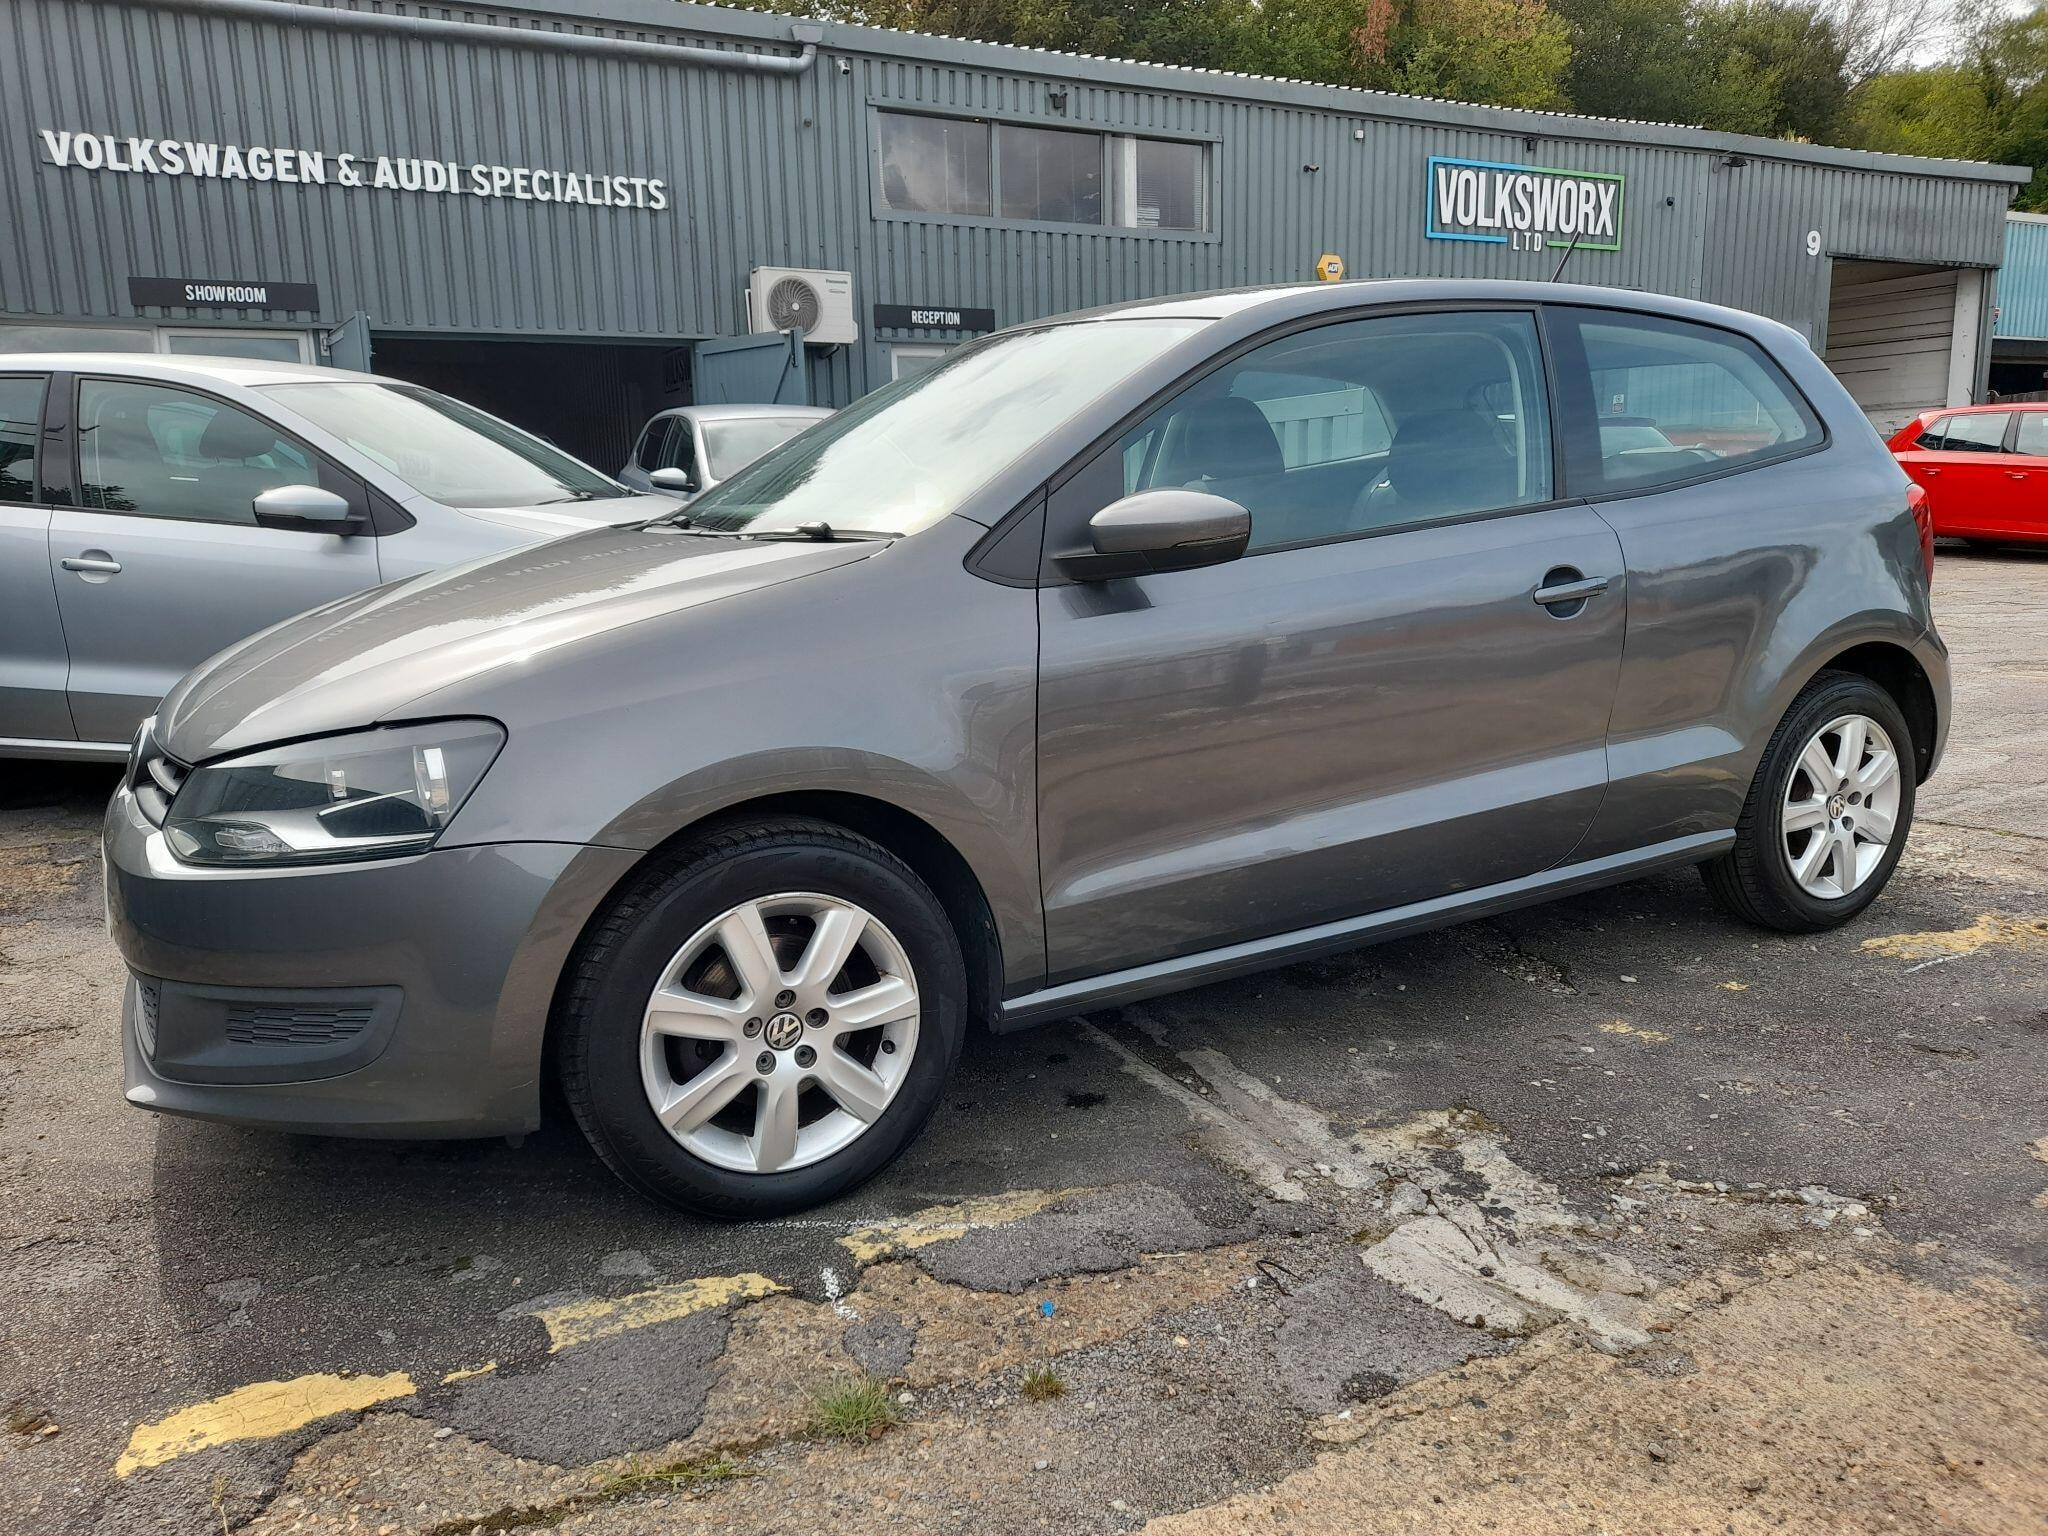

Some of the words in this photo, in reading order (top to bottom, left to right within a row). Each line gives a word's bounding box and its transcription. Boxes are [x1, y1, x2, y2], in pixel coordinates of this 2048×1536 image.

[41, 129, 326, 184] VOLKSWAGEN
[337, 153, 362, 188] &
[374, 156, 460, 194] AUDI
[471, 164, 666, 210] SPECIALISTS
[1437, 167, 1616, 236] VOLKSWORX
[1512, 231, 1542, 252] LTD
[1806, 230, 1821, 256] 9
[185, 285, 267, 303] SHOWROOM
[911, 310, 960, 325] RECEPTION
